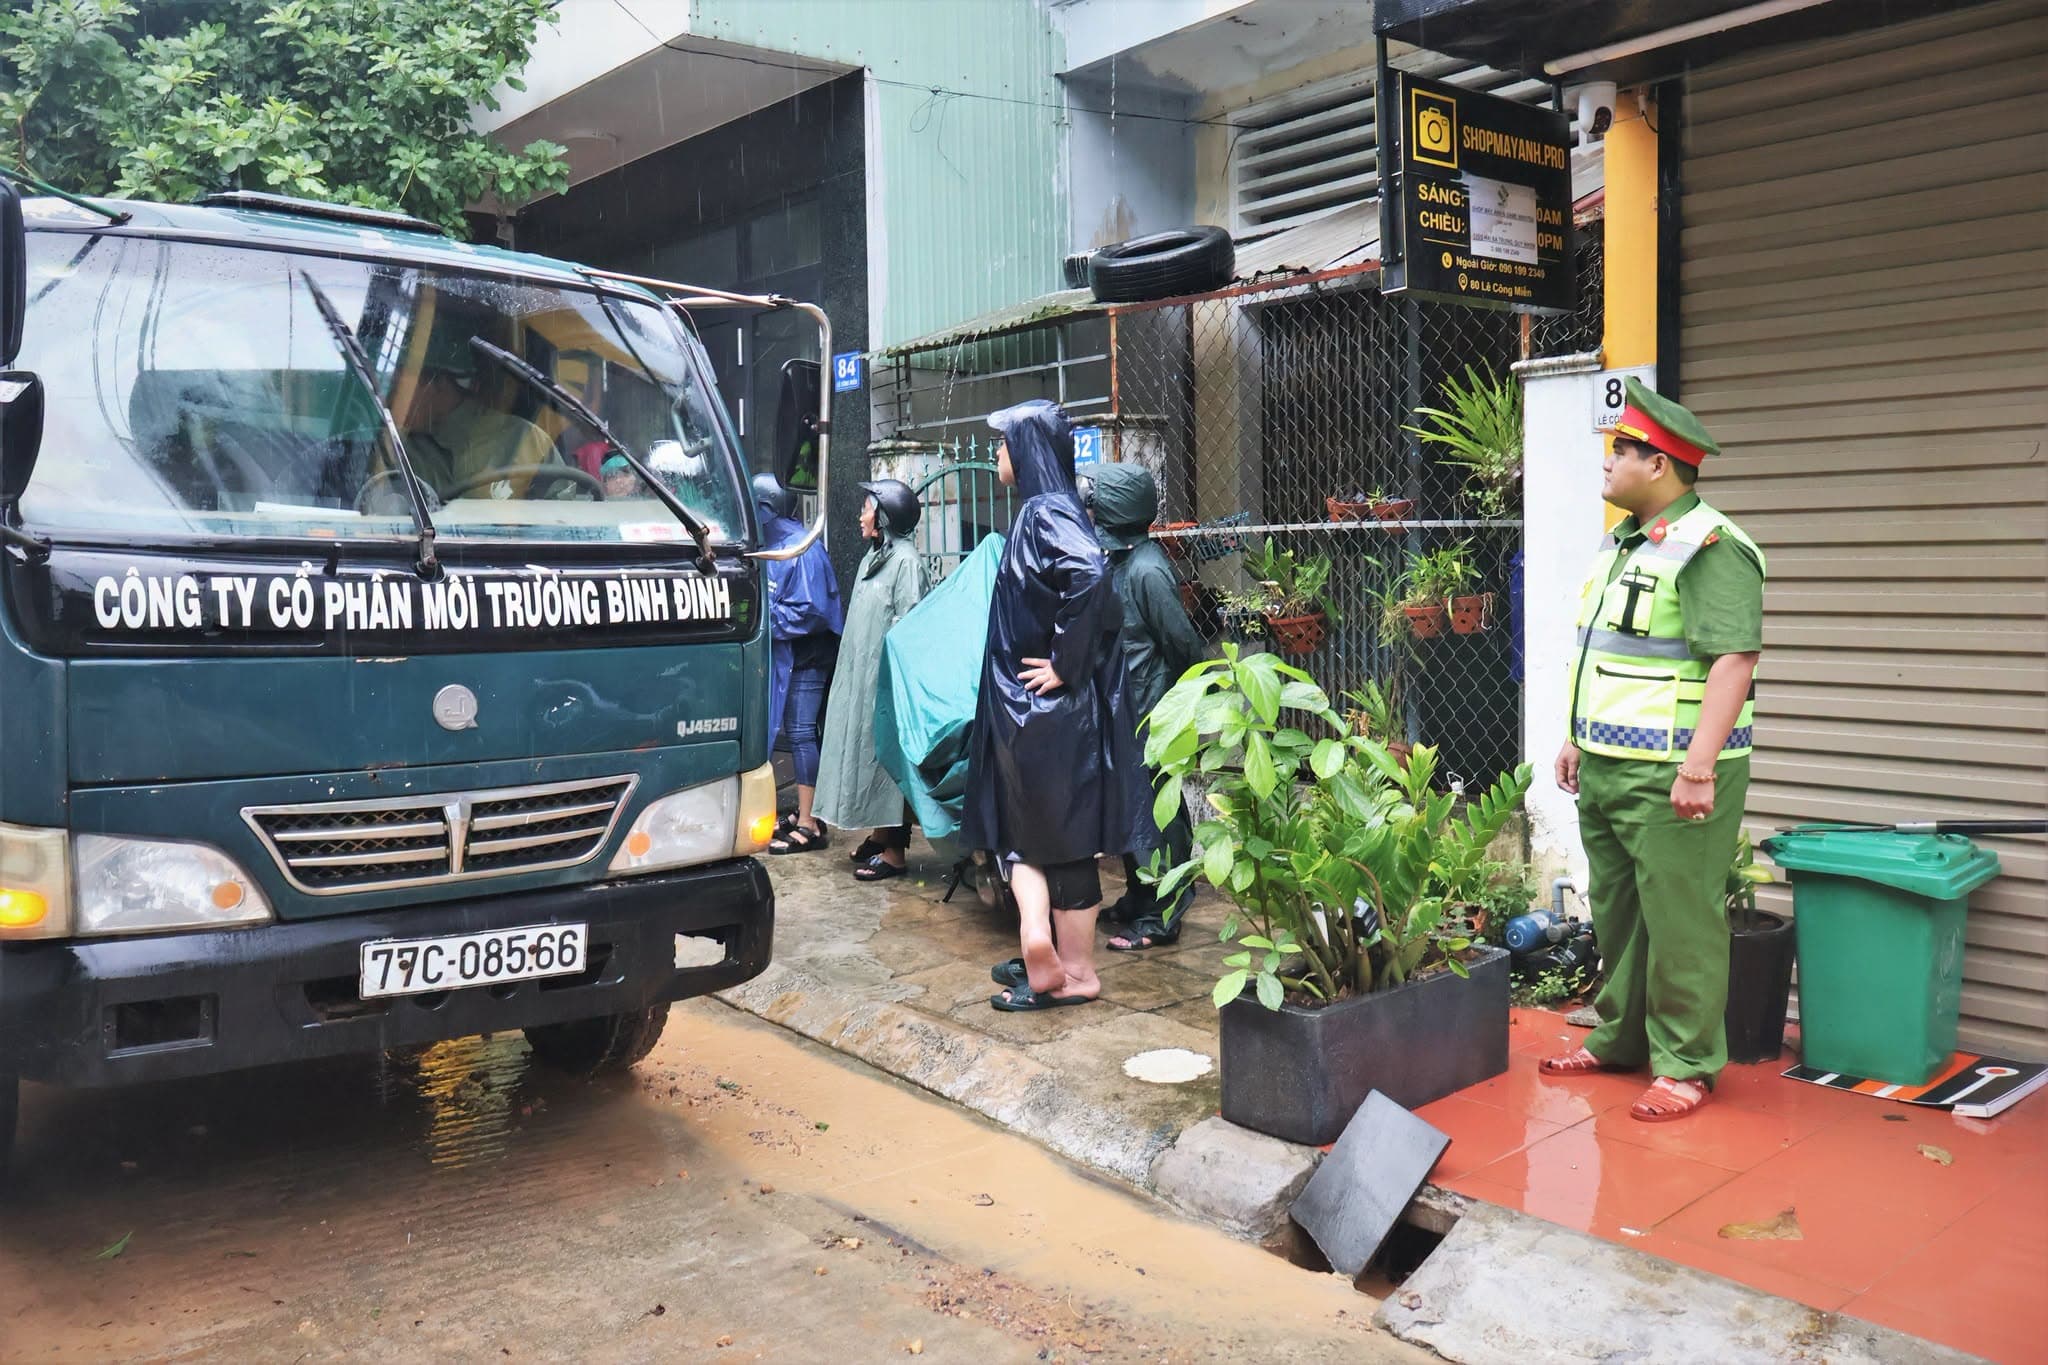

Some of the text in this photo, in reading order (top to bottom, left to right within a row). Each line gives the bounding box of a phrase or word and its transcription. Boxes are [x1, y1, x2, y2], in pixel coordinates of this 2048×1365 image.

[1462, 124, 1565, 170] SHOPMAYANH.PRO
[1418, 181, 1465, 207] SÁNG:
[1419, 210, 1465, 234] CHIỀU:
[1456, 256, 1479, 270] Ngoài
[1499, 263, 1513, 274] 090
[1514, 265, 1527, 277] 199
[1470, 279, 1480, 290] 80
[1492, 283, 1513, 297] Công
[838, 358, 856, 378] 84
[93, 566, 202, 629] CÔNG
[211, 577, 257, 627] TY
[268, 561, 315, 628] CỔ
[421, 575, 478, 630] MÔI
[371, 930, 578, 989] 77C-085.66
